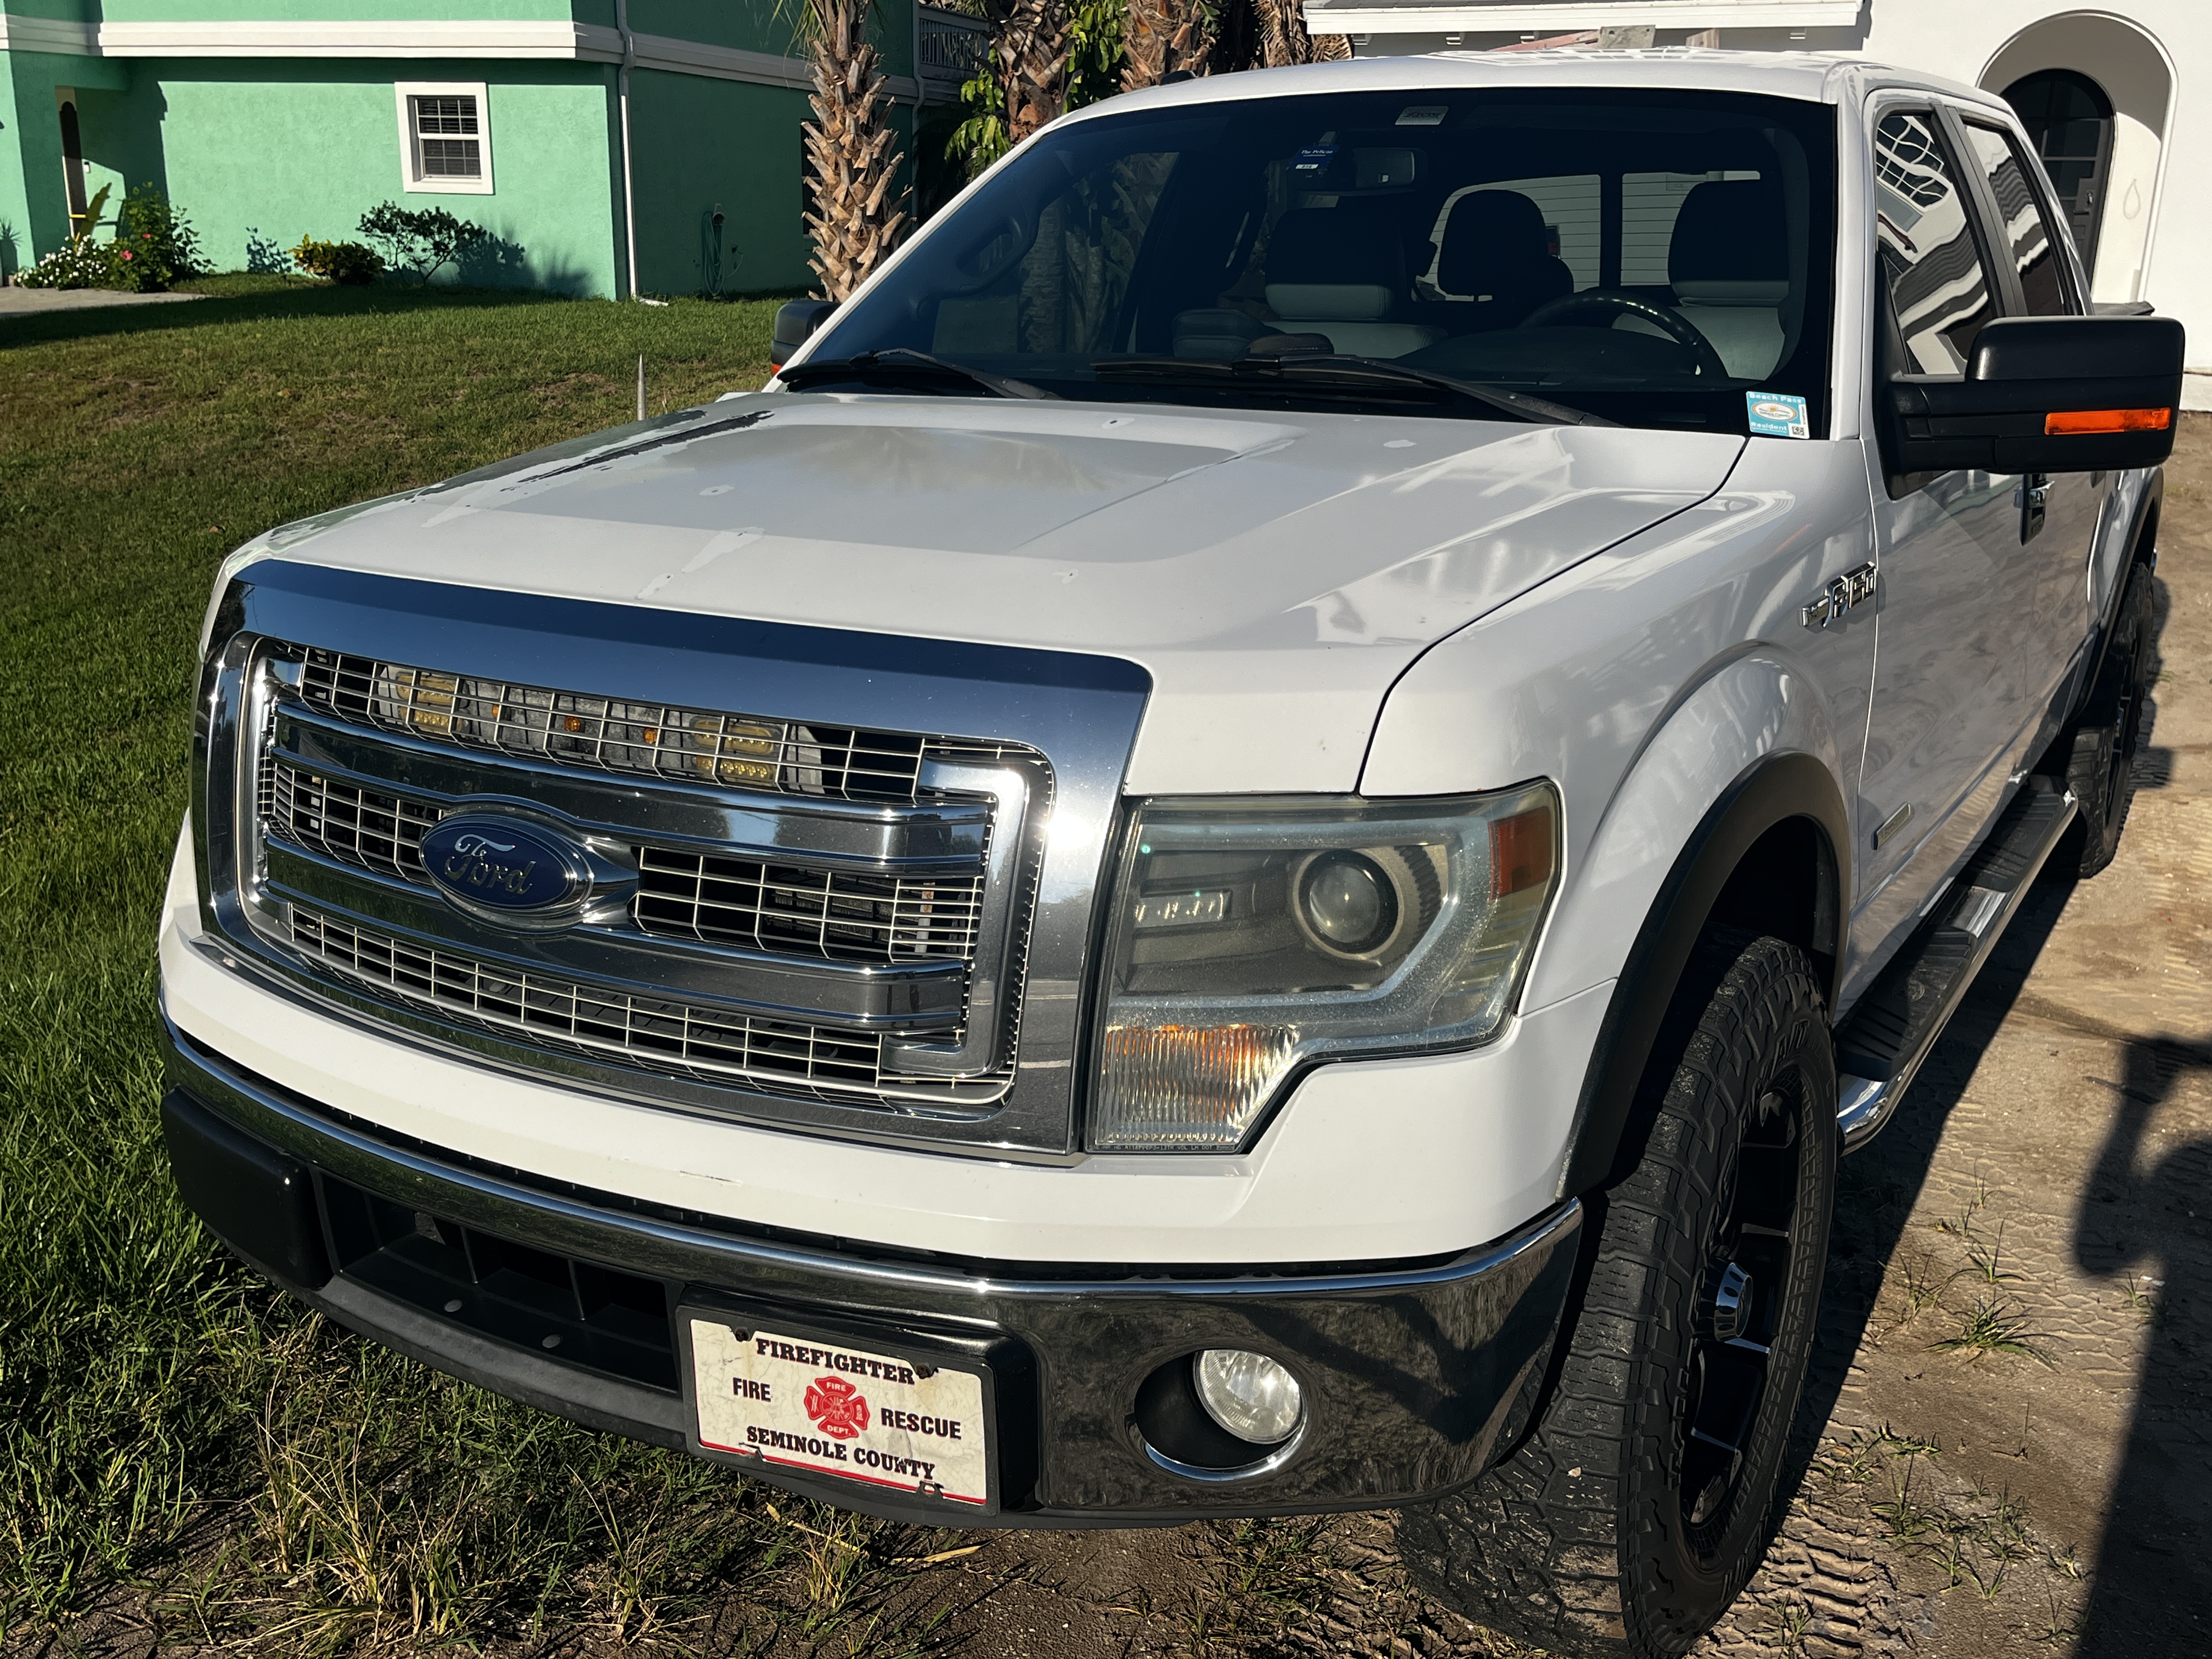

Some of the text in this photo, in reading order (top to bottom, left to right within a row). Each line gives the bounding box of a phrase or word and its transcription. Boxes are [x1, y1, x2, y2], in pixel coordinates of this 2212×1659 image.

[1750, 393, 1802, 404] Beach Pass
[1751, 422, 1787, 431] Resident
[445, 833, 537, 895] Ford
[756, 1338, 915, 1385] FIREFIGHTER
[732, 1378, 962, 1440] FIRE RESCUE
[826, 1381, 847, 1392] FIRE
[747, 1426, 935, 1480] SEMINOLE COUNTY
